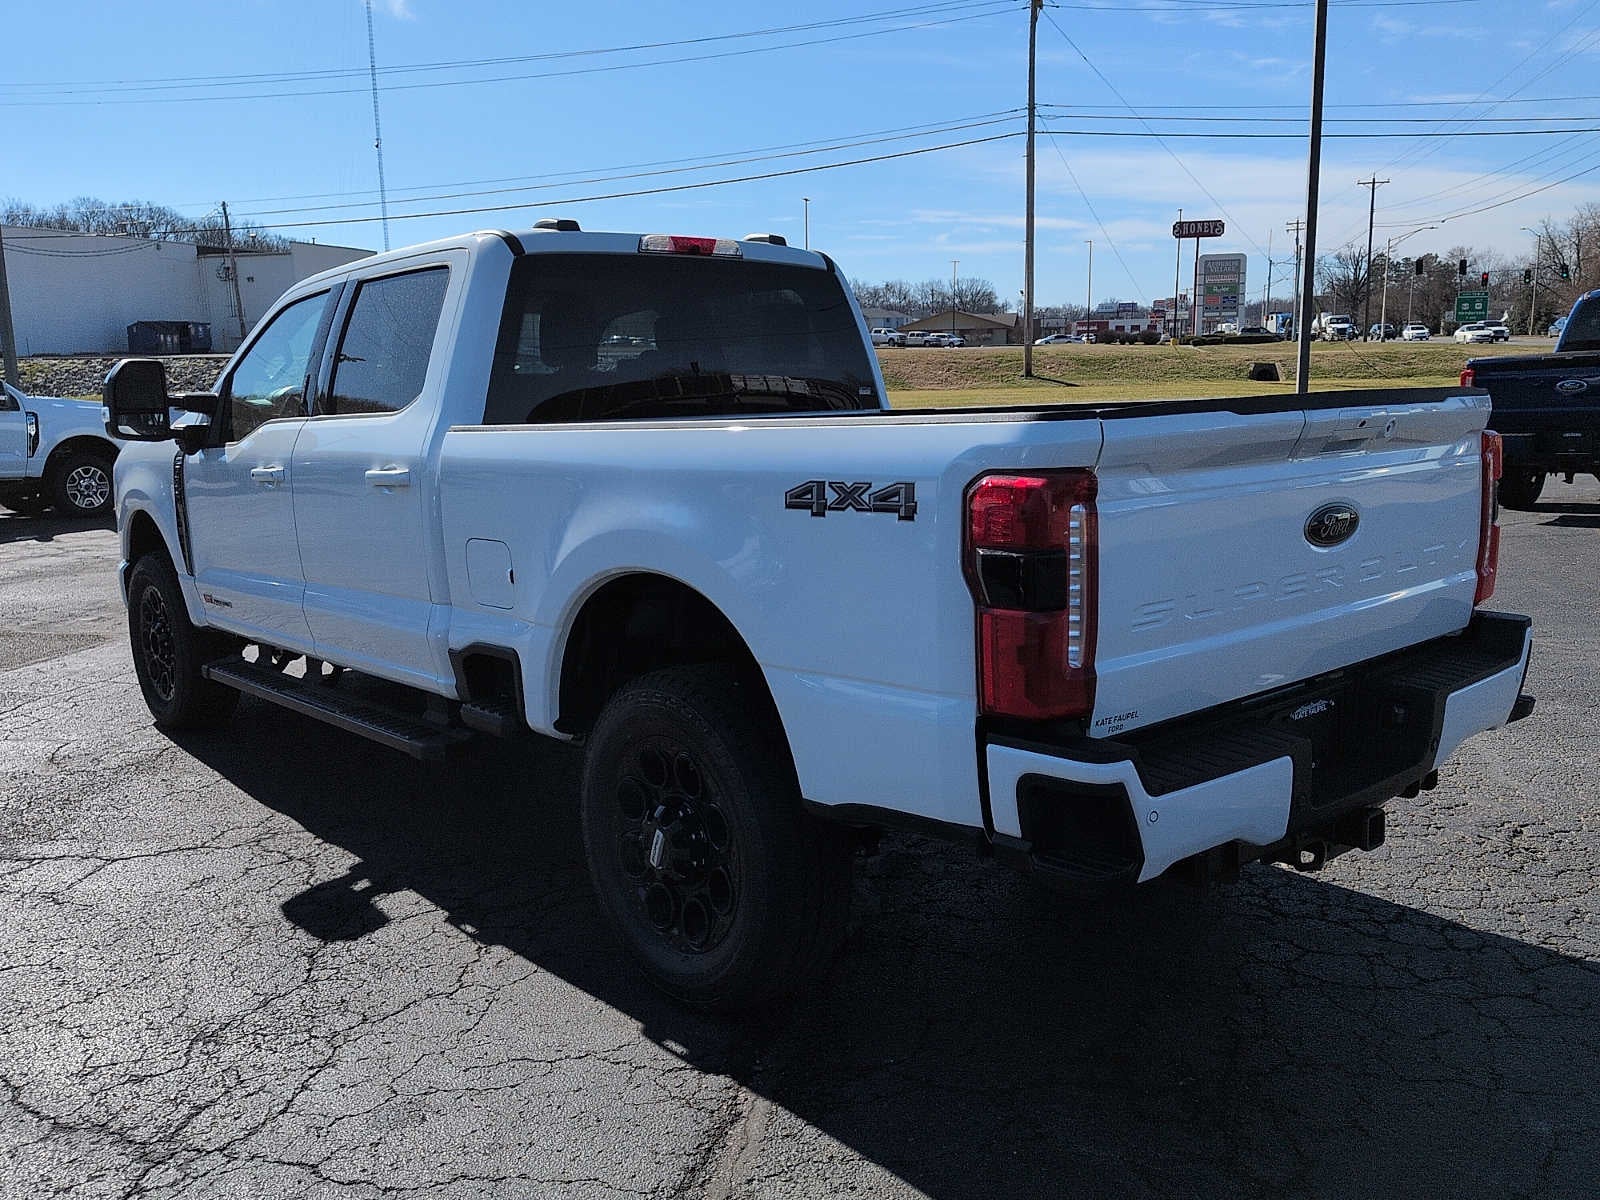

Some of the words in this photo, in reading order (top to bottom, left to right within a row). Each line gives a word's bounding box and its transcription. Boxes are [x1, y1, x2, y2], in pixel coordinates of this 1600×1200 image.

[1321, 512, 1351, 538] Ford
[1095, 716, 1113, 727] KATE
[1113, 711, 1139, 723] FAUPEL
[1107, 724, 1124, 733] FORD
